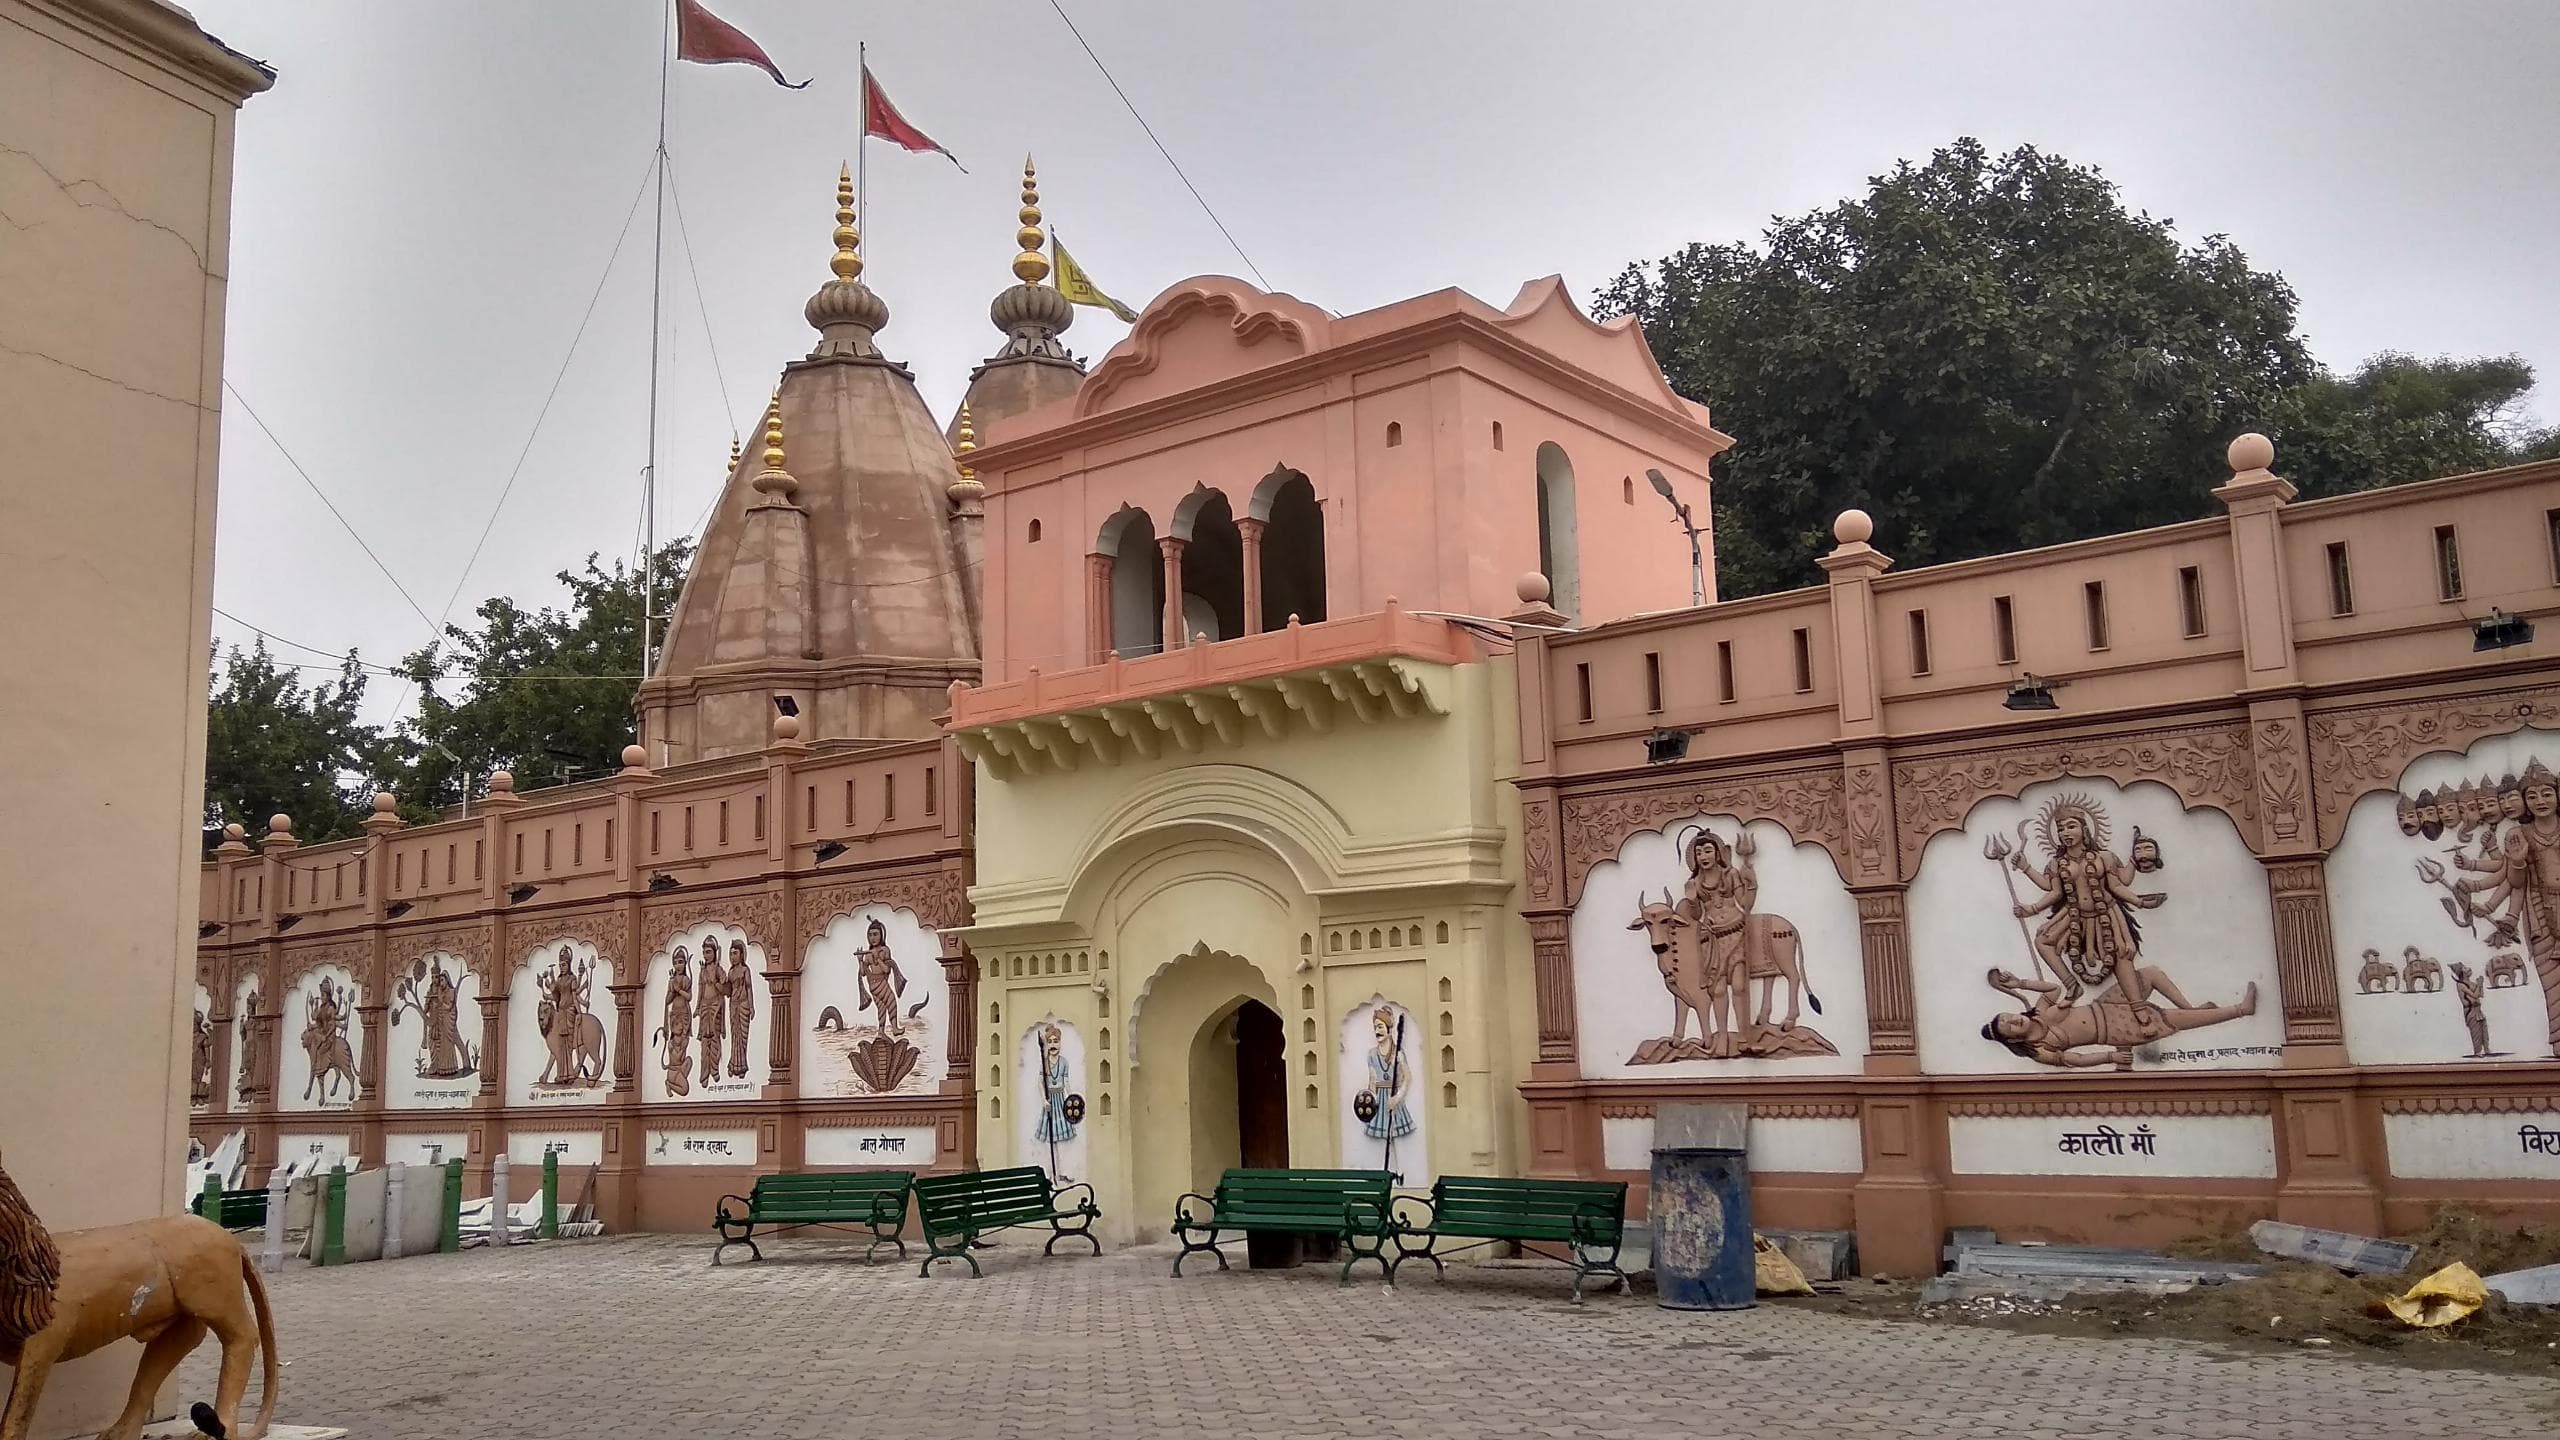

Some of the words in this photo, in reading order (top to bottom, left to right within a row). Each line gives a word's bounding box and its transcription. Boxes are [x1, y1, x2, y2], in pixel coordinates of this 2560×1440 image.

[692, 1140, 705, 1153] राम
[878, 1133, 906, 1154] गोपाल
[2058, 1124, 2125, 1156] काली
[2129, 1123, 2156, 1156] माँ
